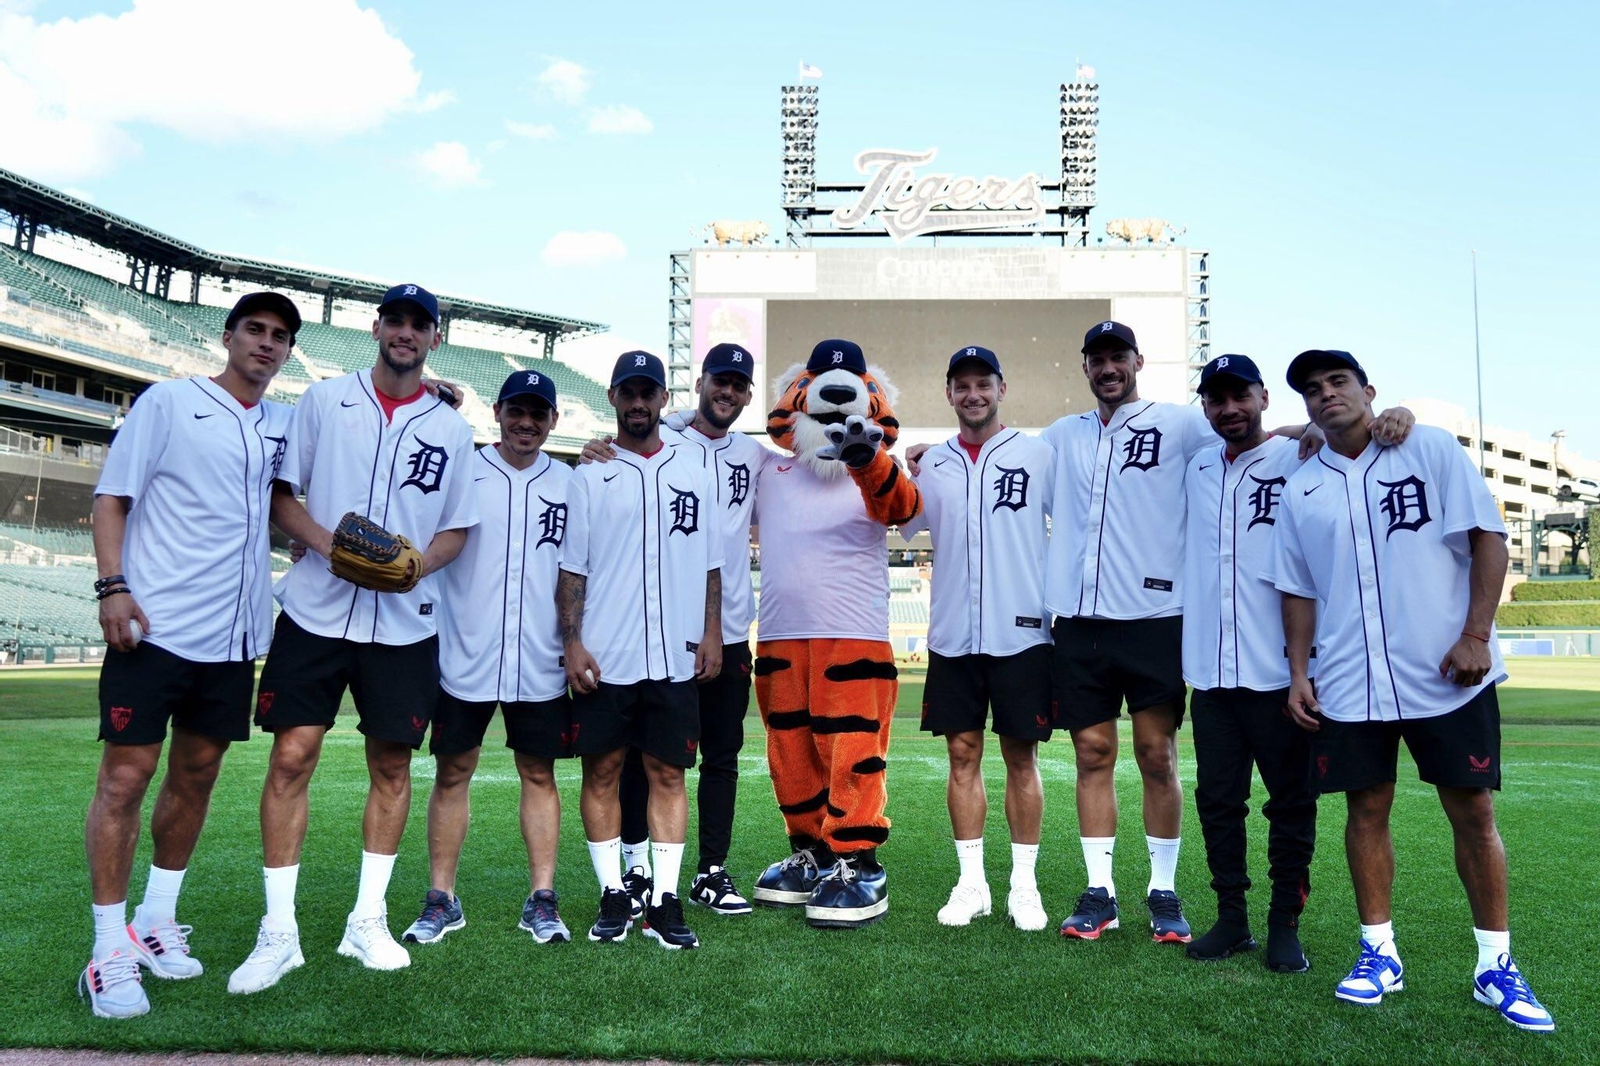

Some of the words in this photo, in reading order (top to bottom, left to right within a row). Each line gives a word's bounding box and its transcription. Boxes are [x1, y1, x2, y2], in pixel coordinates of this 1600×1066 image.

[832, 148, 1046, 237] Tigers
[403, 285, 418, 296] D
[1101, 321, 1114, 333] D
[634, 354, 647, 367] D
[731, 350, 743, 363] D
[831, 350, 844, 365] D
[1216, 356, 1229, 371] D
[527, 373, 540, 386] D
[399, 436, 450, 495] D
[1120, 425, 1164, 473] D
[725, 461, 751, 506] D
[992, 464, 1032, 513] D
[536, 496, 568, 550] D
[668, 483, 700, 536] D
[1377, 475, 1432, 541] D
